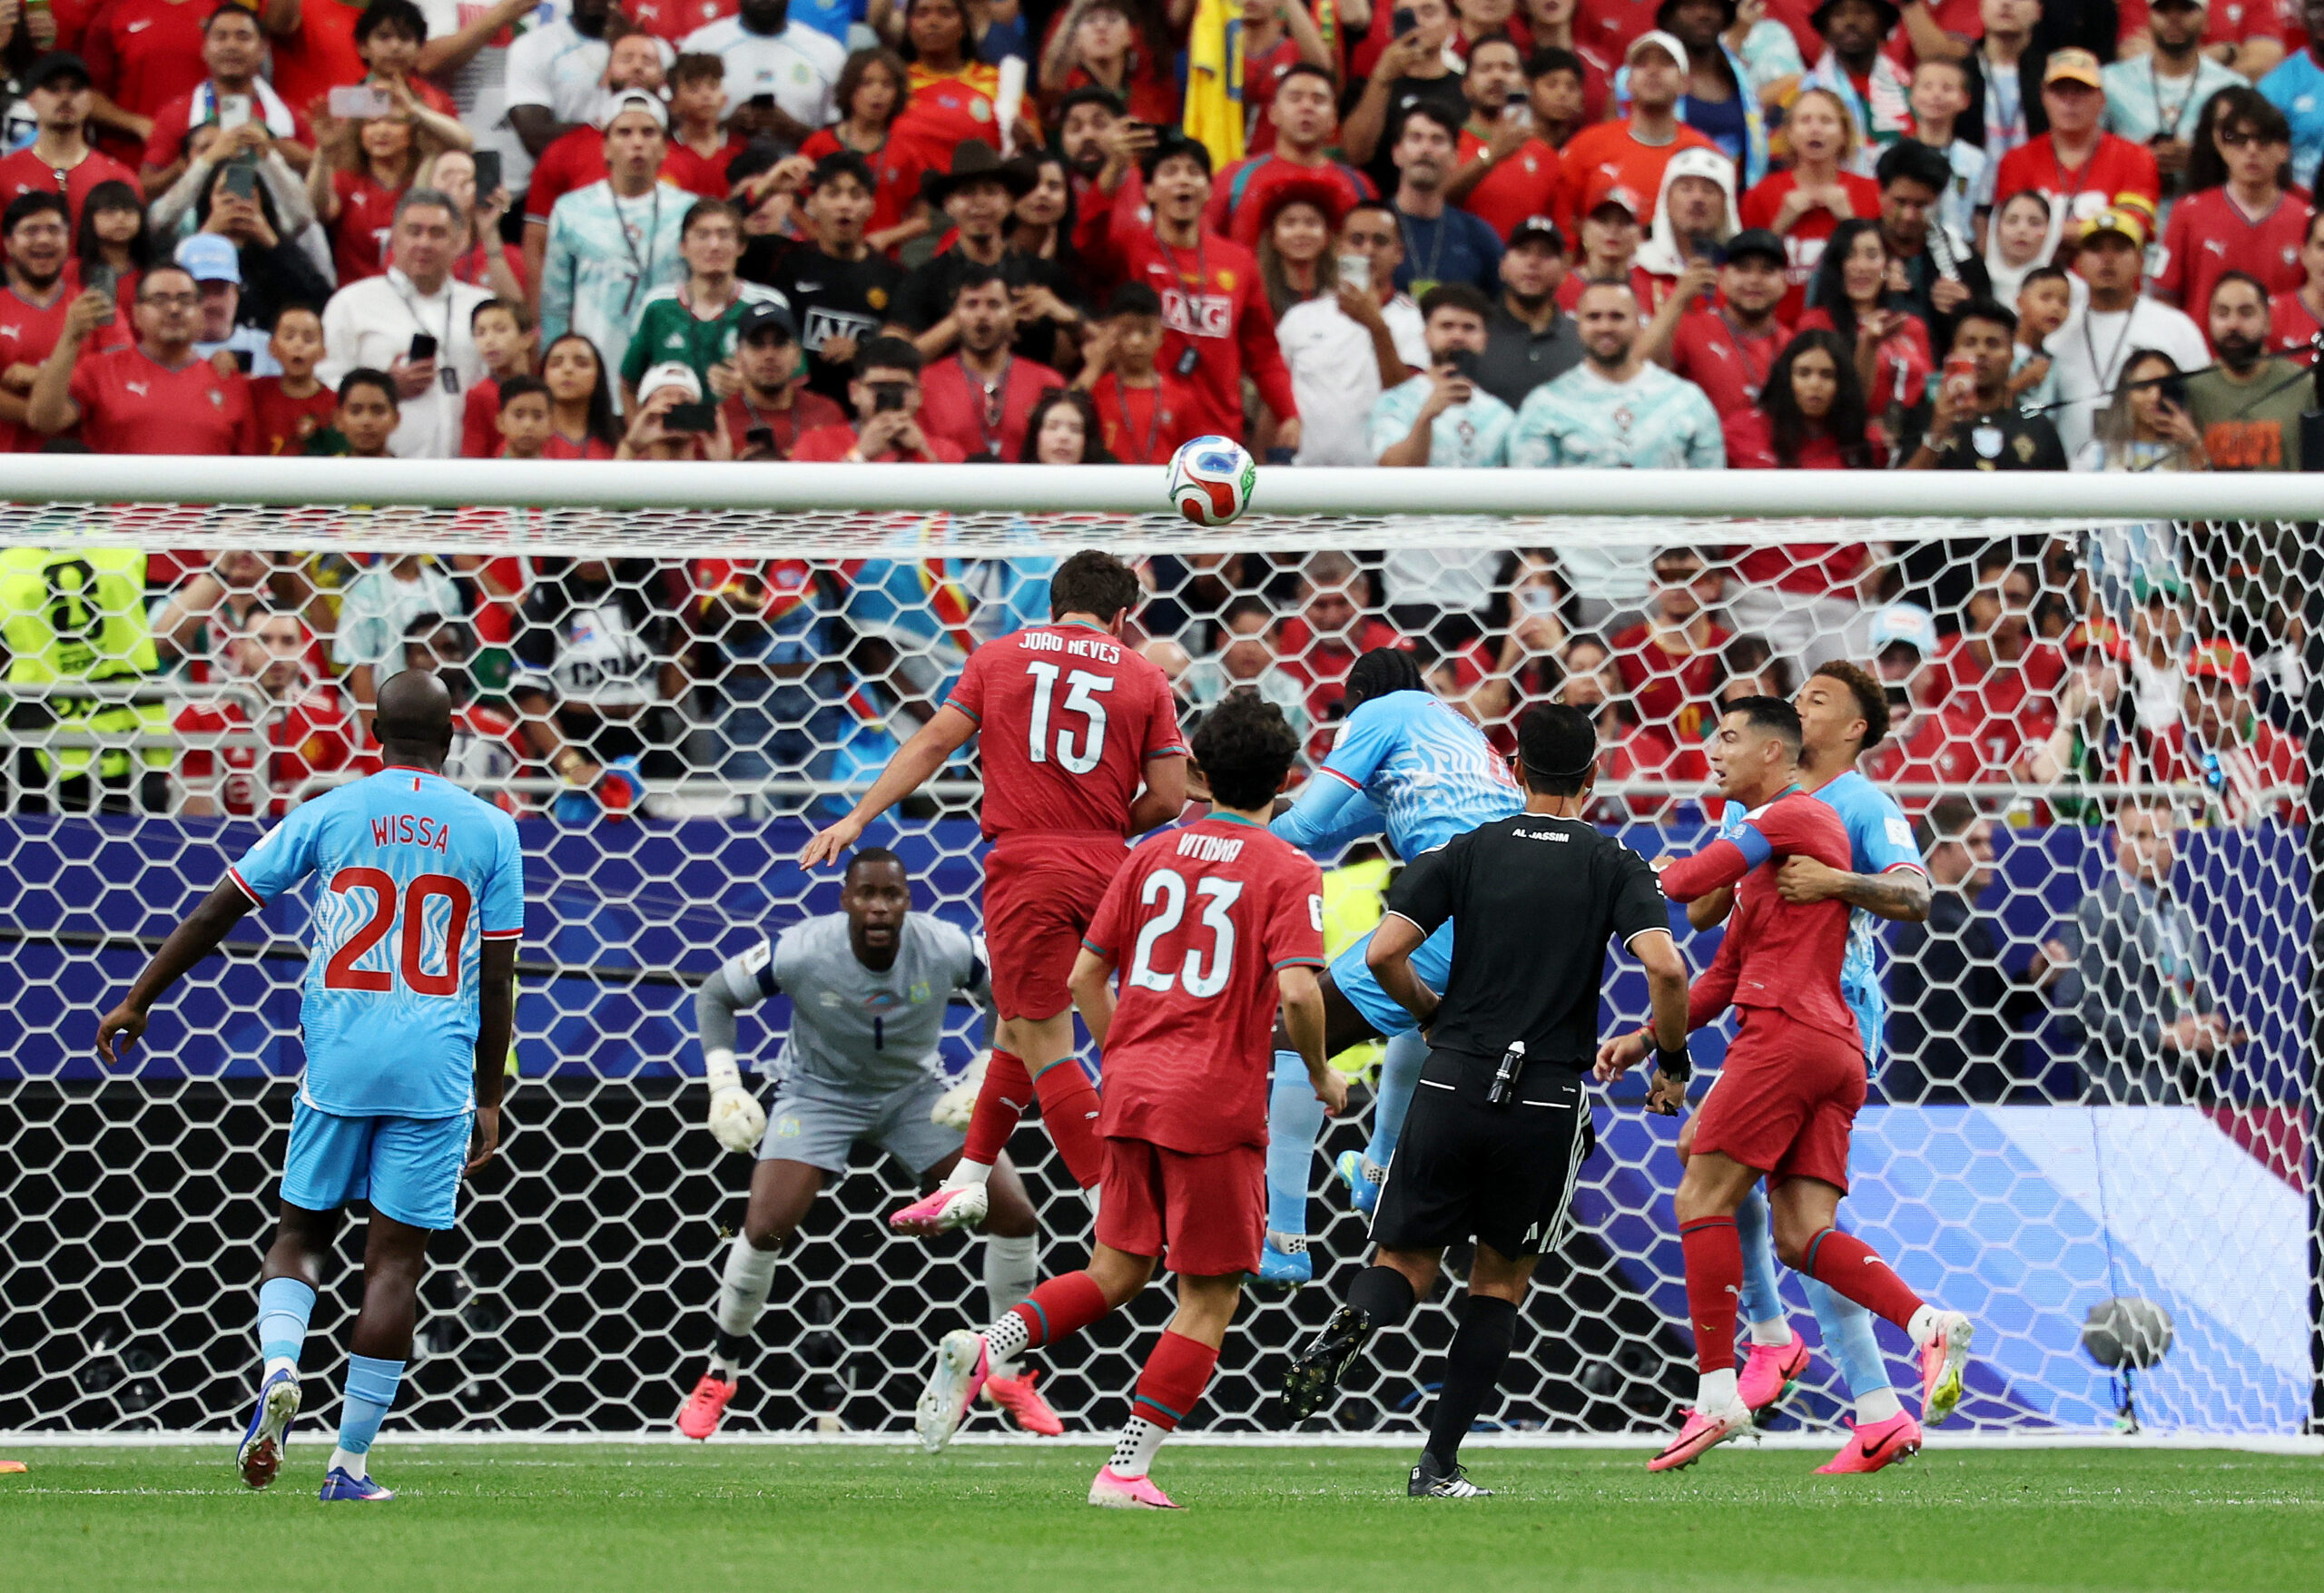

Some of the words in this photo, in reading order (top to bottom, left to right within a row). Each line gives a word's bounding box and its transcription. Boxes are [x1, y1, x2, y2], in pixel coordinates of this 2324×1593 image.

[1019, 632, 1063, 652] JOÃO
[1067, 639, 1121, 664] NEVES
[1025, 660, 1116, 775] 15
[370, 813, 450, 855] WISSA
[1176, 832, 1245, 863] VITINHA
[1512, 828, 1527, 838] AL
[1528, 831, 1570, 843] JASSIM
[324, 866, 472, 998] 20
[1128, 867, 1245, 998] 23
[873, 1016, 884, 1050] 1
